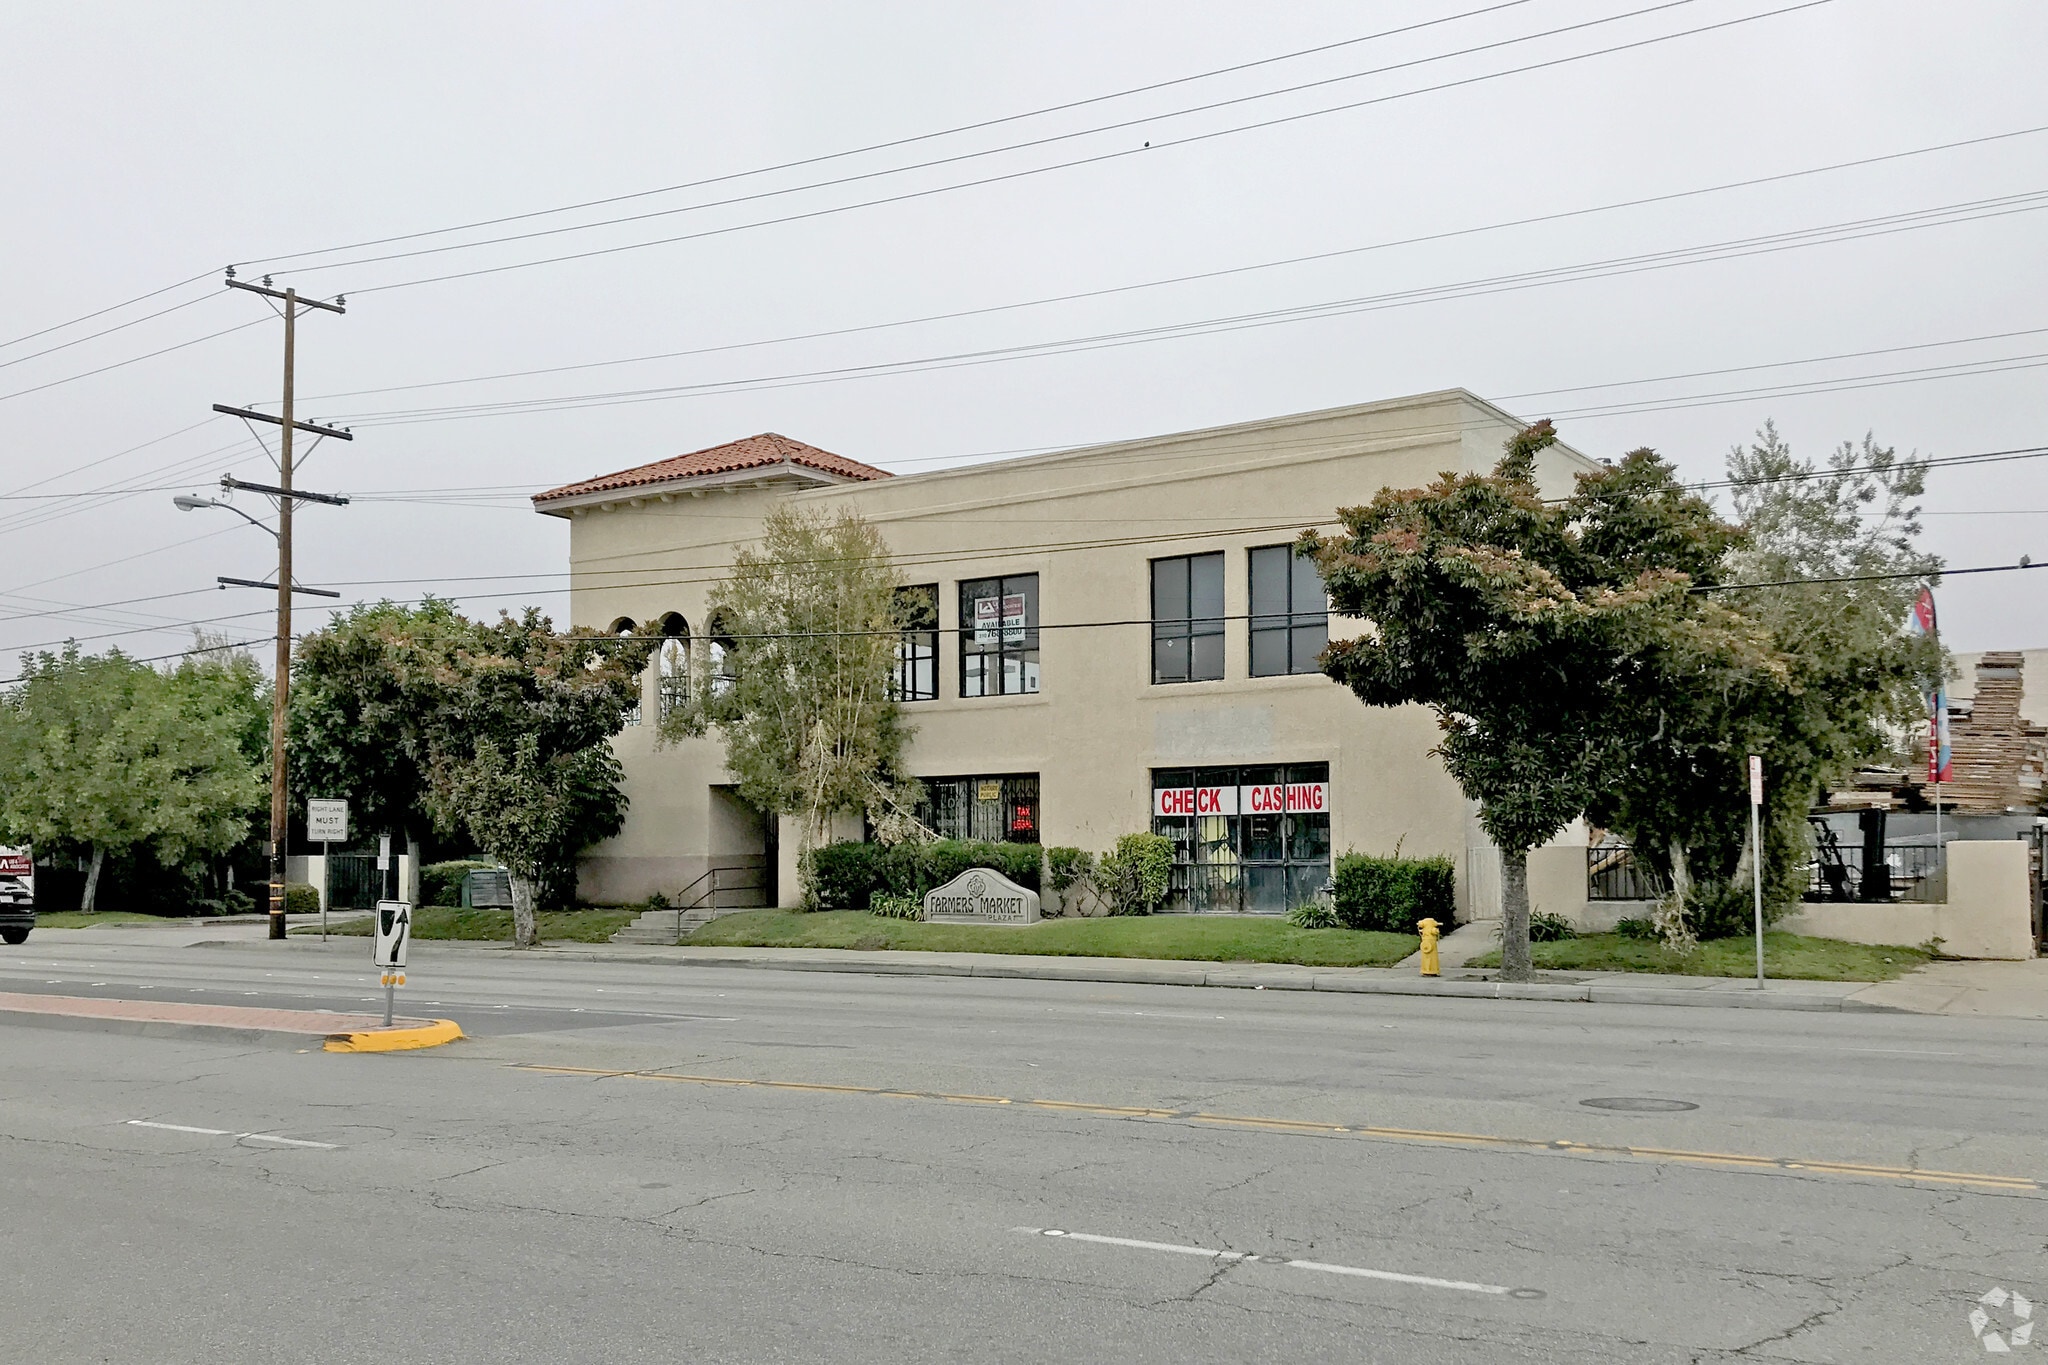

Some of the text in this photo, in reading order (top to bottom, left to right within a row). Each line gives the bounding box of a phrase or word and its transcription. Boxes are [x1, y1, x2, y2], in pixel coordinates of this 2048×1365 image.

[981, 618, 1020, 629] AVAIABLE
[1161, 784, 1323, 814] CHECK CASHING
[1017, 806, 1031, 816] TAX
[1012, 819, 1033, 830] LEGAL
[930, 896, 1024, 914] FARMERS MARKET
